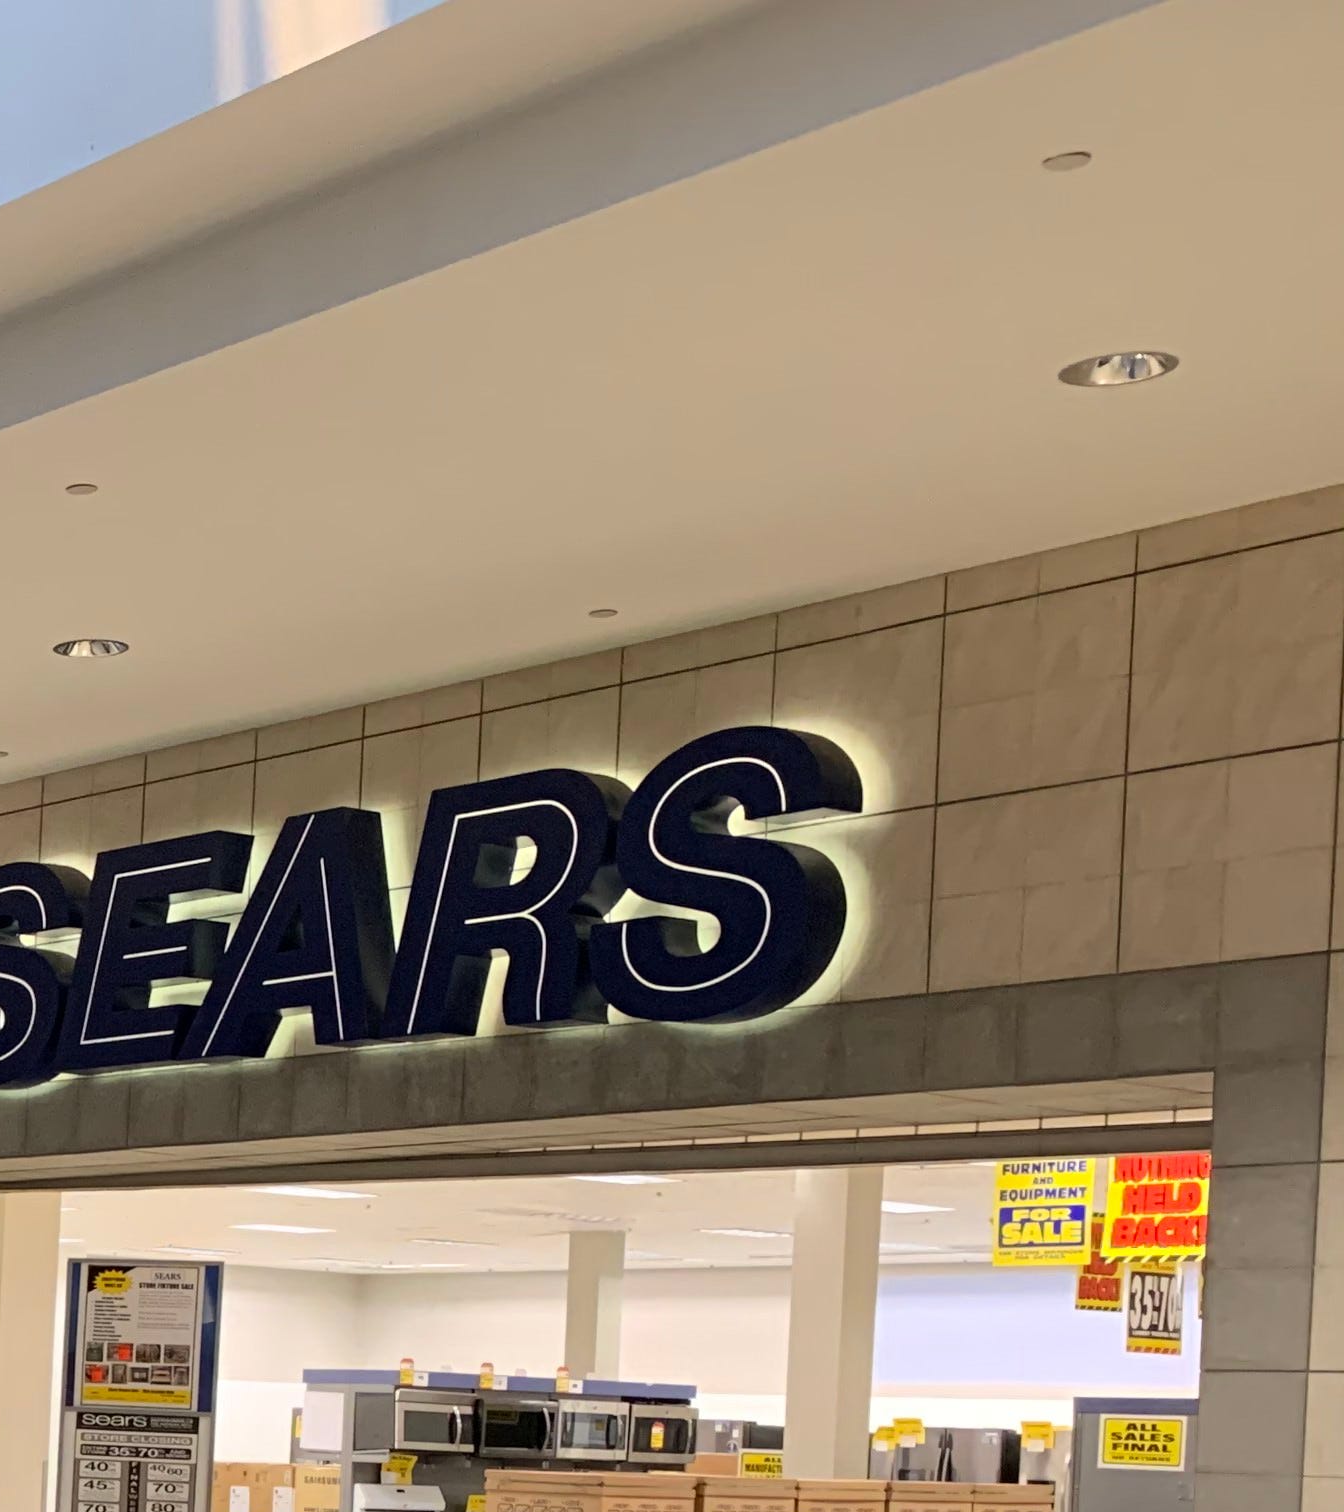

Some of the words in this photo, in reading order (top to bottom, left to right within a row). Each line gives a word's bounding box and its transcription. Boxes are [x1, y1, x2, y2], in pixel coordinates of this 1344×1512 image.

[1002, 1160, 1087, 1176] FURNITURE
[1032, 1177, 1053, 1185] AND
[999, 1187, 1087, 1202] EQUIPMENT
[1122, 1182, 1202, 1215] HELD
[1012, 1207, 1072, 1222] FOR
[1001, 1221, 1082, 1245] SALE
[81, 1413, 147, 1428] sears
[1125, 1423, 1161, 1432] ALL
[83, 1433, 128, 1443] STORE
[131, 1435, 191, 1445] CLOSING
[1110, 1432, 1175, 1442] SALES
[1112, 1443, 1172, 1453] FINAL
[85, 1461, 109, 1472] 40
[84, 1480, 108, 1490] 45
[153, 1483, 177, 1493] 70
